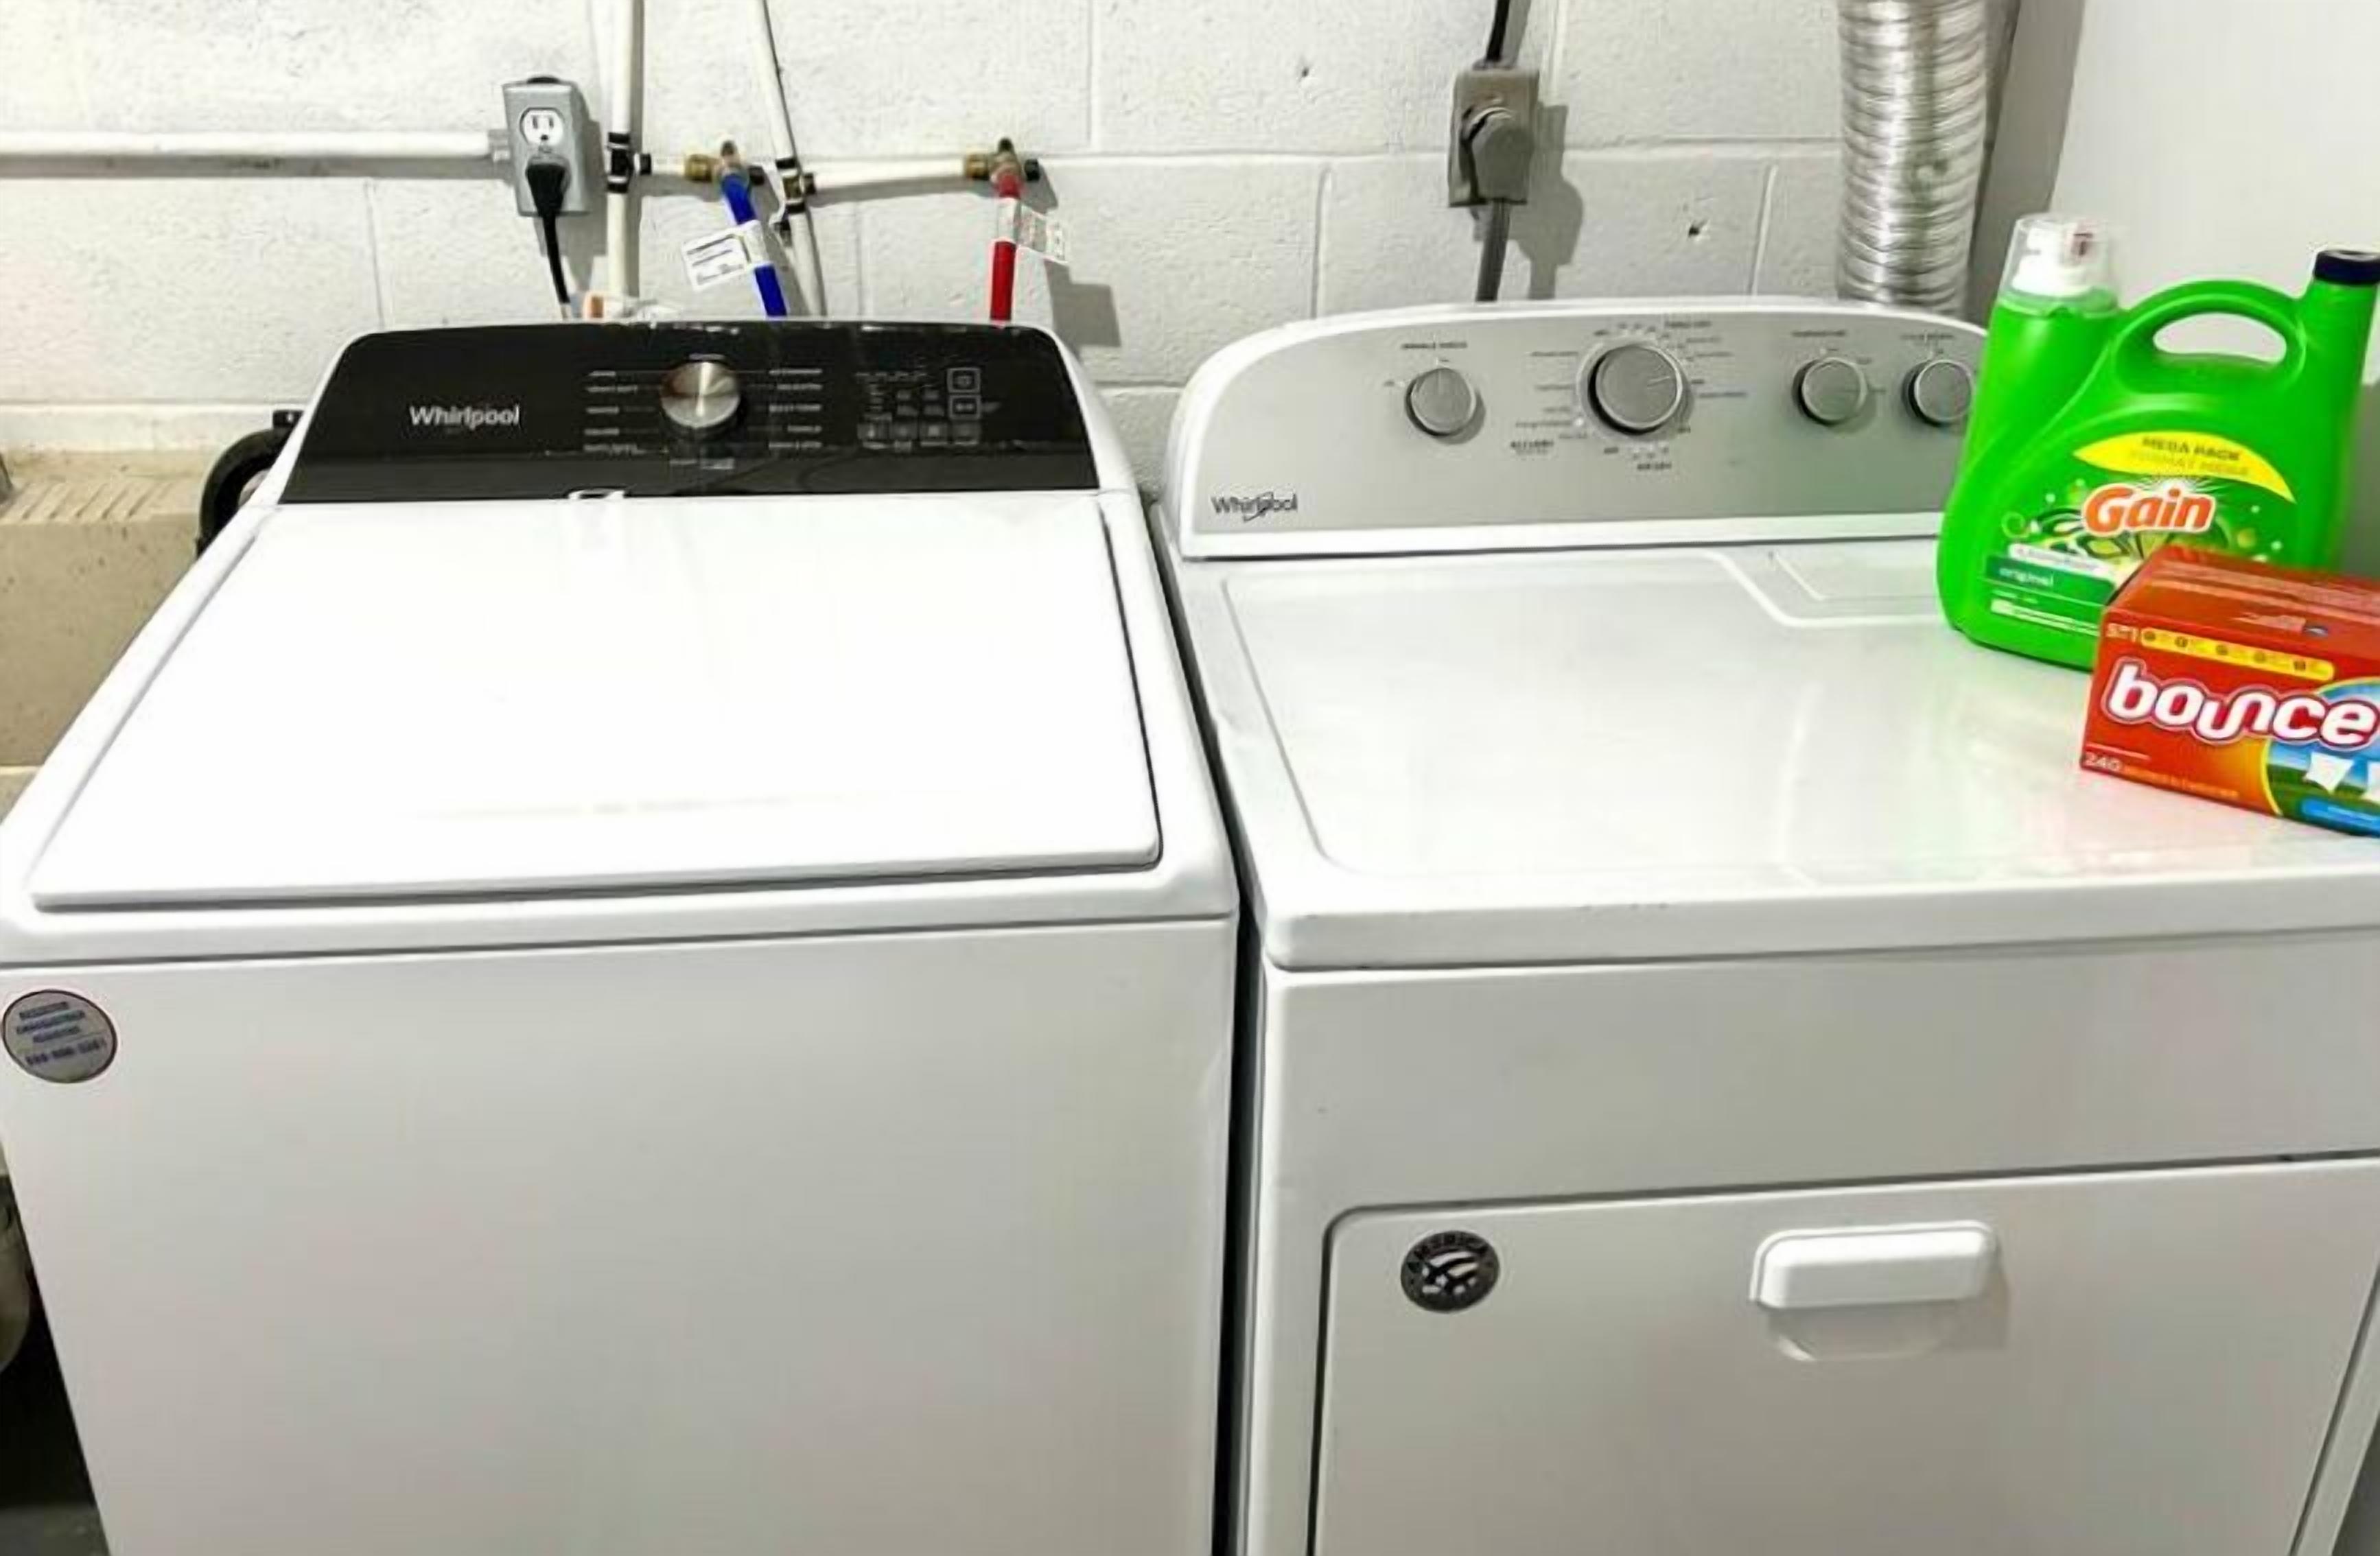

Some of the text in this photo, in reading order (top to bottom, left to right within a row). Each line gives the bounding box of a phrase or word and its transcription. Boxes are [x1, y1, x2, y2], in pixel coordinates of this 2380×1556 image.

[410, 403, 520, 430] Whirlpool
[1210, 492, 1298, 520] Whirlpool
[2084, 486, 2214, 535] Gain
[1998, 567, 2054, 588] original
[2105, 659, 2379, 748] bounce
[2085, 751, 2122, 772] 240
